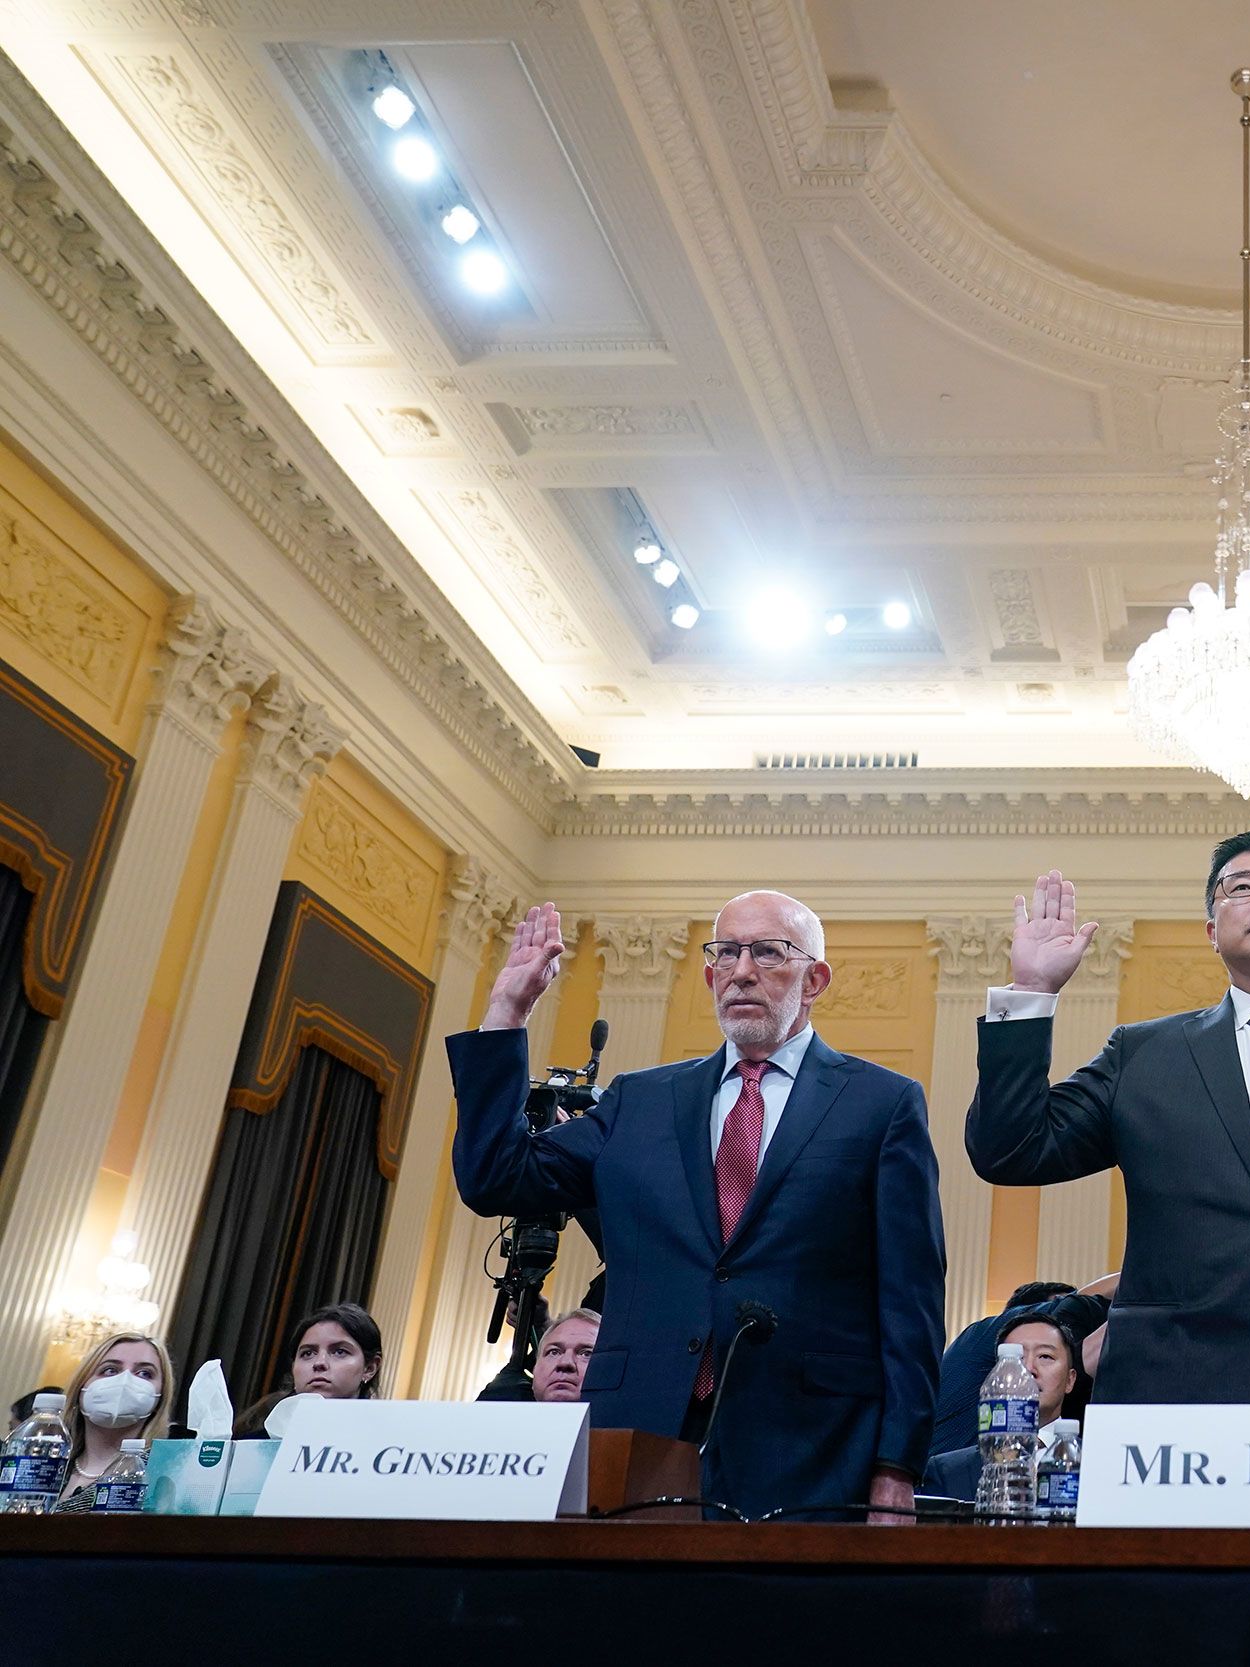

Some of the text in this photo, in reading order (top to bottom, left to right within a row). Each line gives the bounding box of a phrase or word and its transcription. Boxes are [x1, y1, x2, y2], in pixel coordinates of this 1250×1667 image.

[291, 1446, 547, 1476] MR. GINSBERG
[1121, 1444, 1227, 1486] MR.
